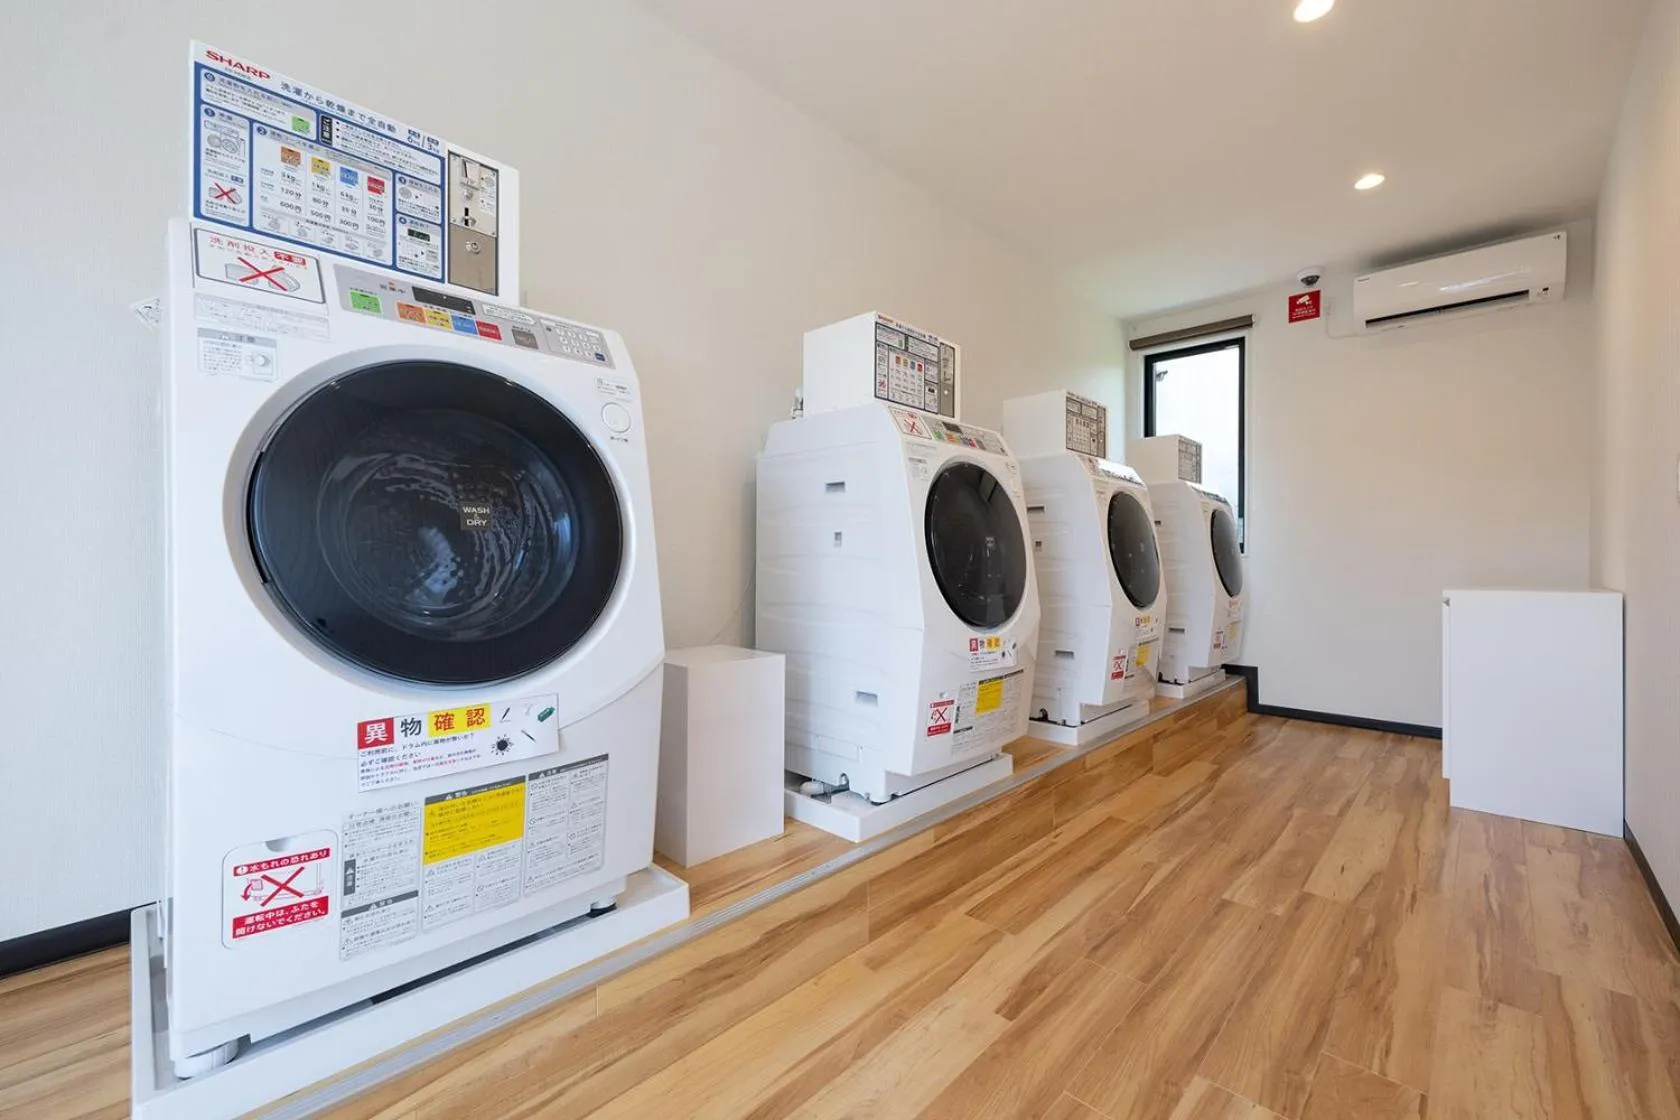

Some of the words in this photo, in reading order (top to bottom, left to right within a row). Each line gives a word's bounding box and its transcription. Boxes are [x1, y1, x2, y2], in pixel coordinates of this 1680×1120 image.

[205, 49, 272, 80] SHARP
[462, 506, 490, 514] WASH
[466, 519, 487, 527] DRY
